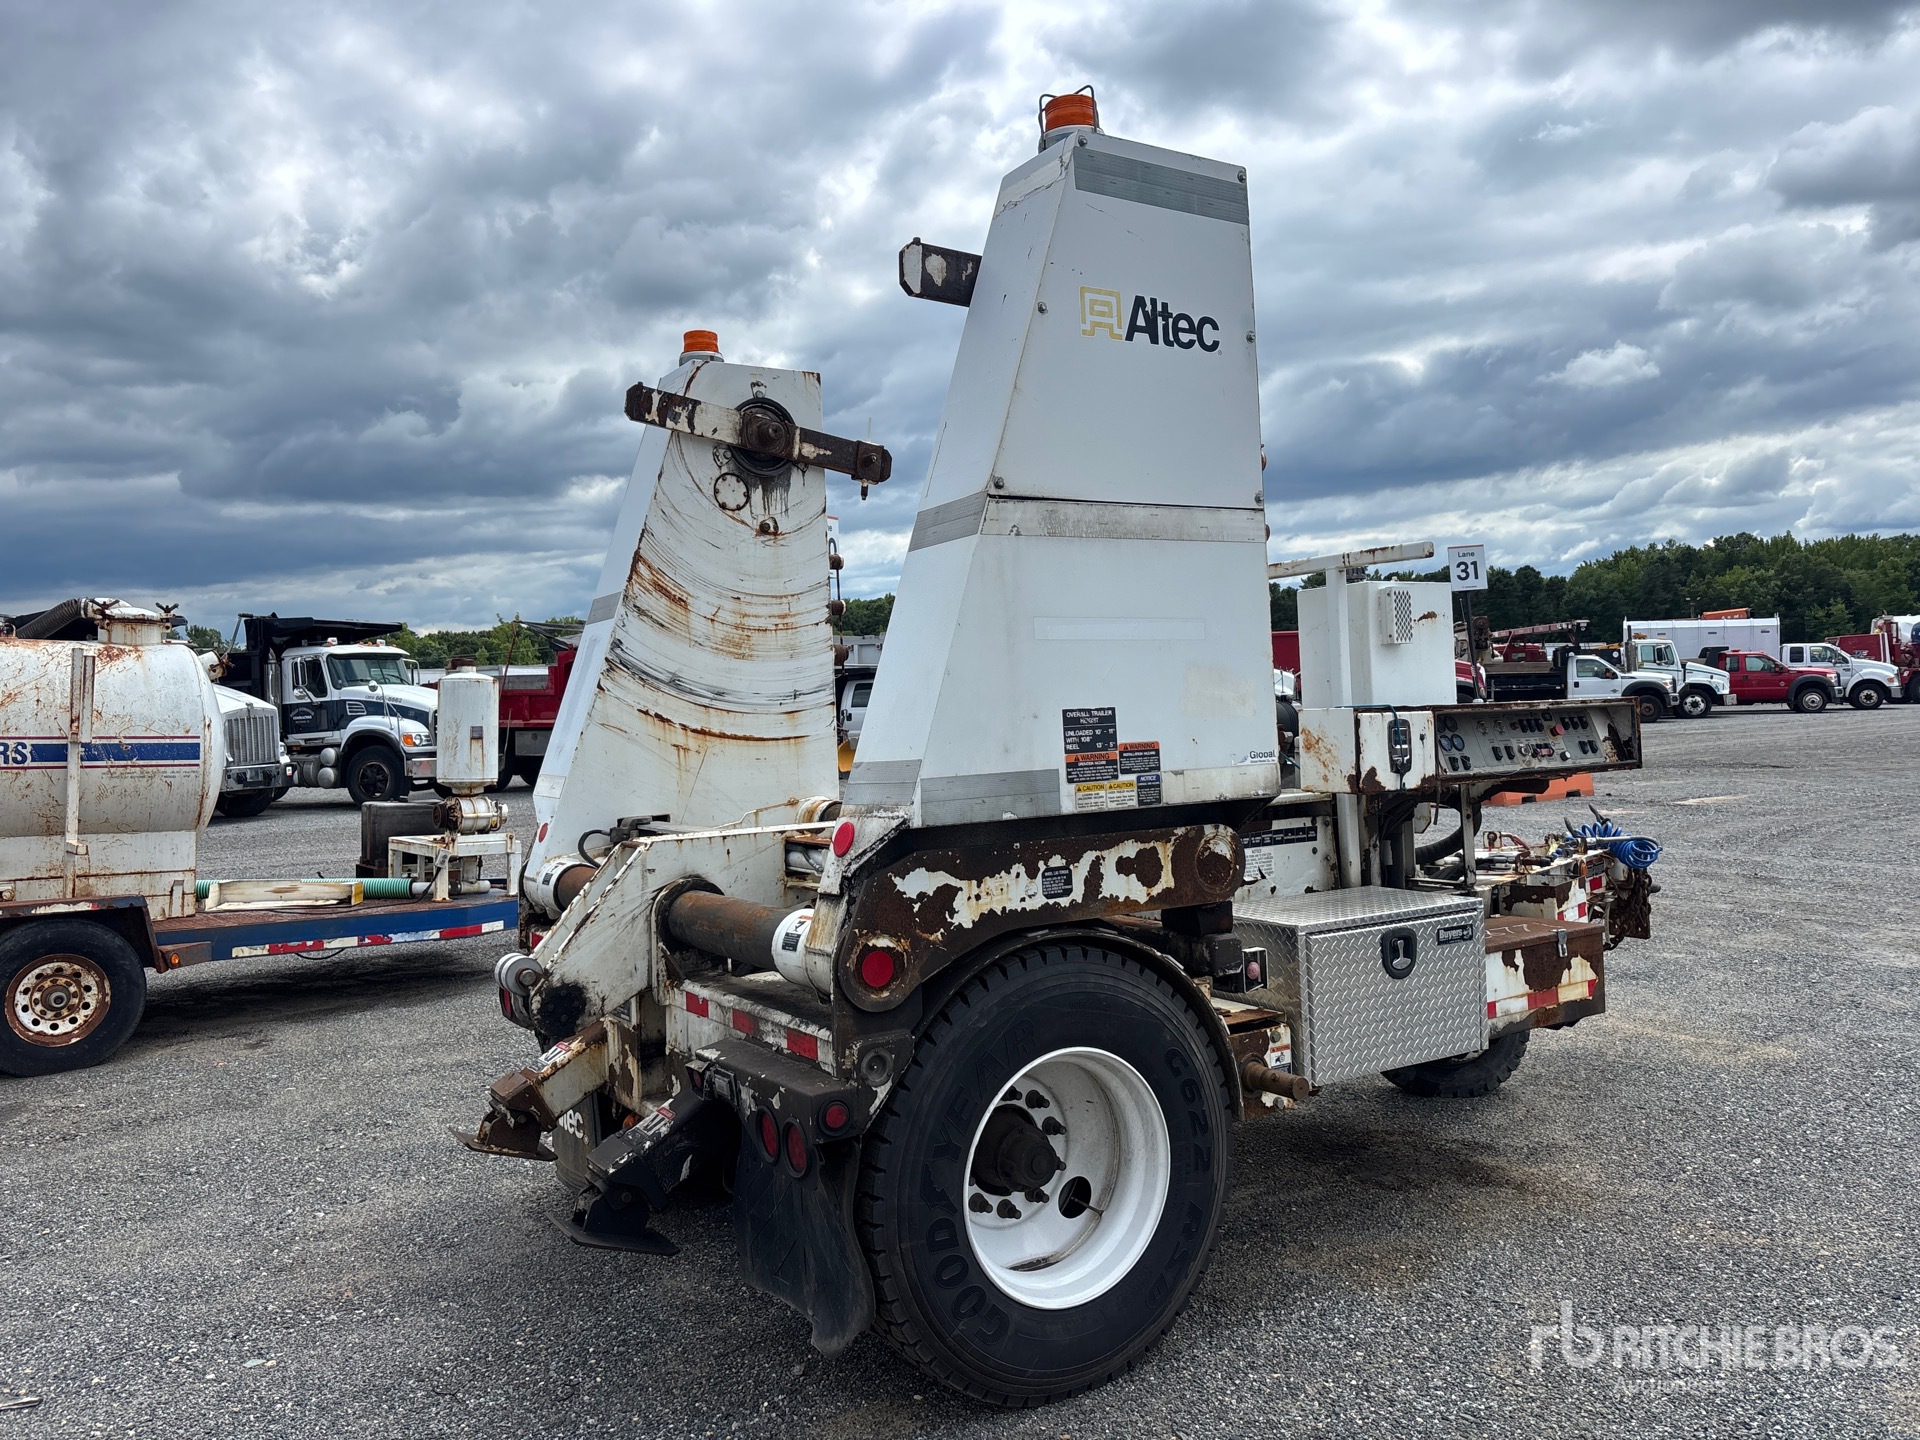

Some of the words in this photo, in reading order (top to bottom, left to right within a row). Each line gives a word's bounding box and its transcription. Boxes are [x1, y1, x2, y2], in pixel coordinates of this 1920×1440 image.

[1125, 295, 1220, 352] Altec
[1456, 561, 1479, 581] 31
[1065, 729, 1094, 737] UNLOADED
[1080, 752, 1110, 761] WARNING
[1440, 929, 1463, 939] Buyers
[1163, 1047, 1211, 1174] G622
[920, 1017, 1040, 1346] GOODYEAR
